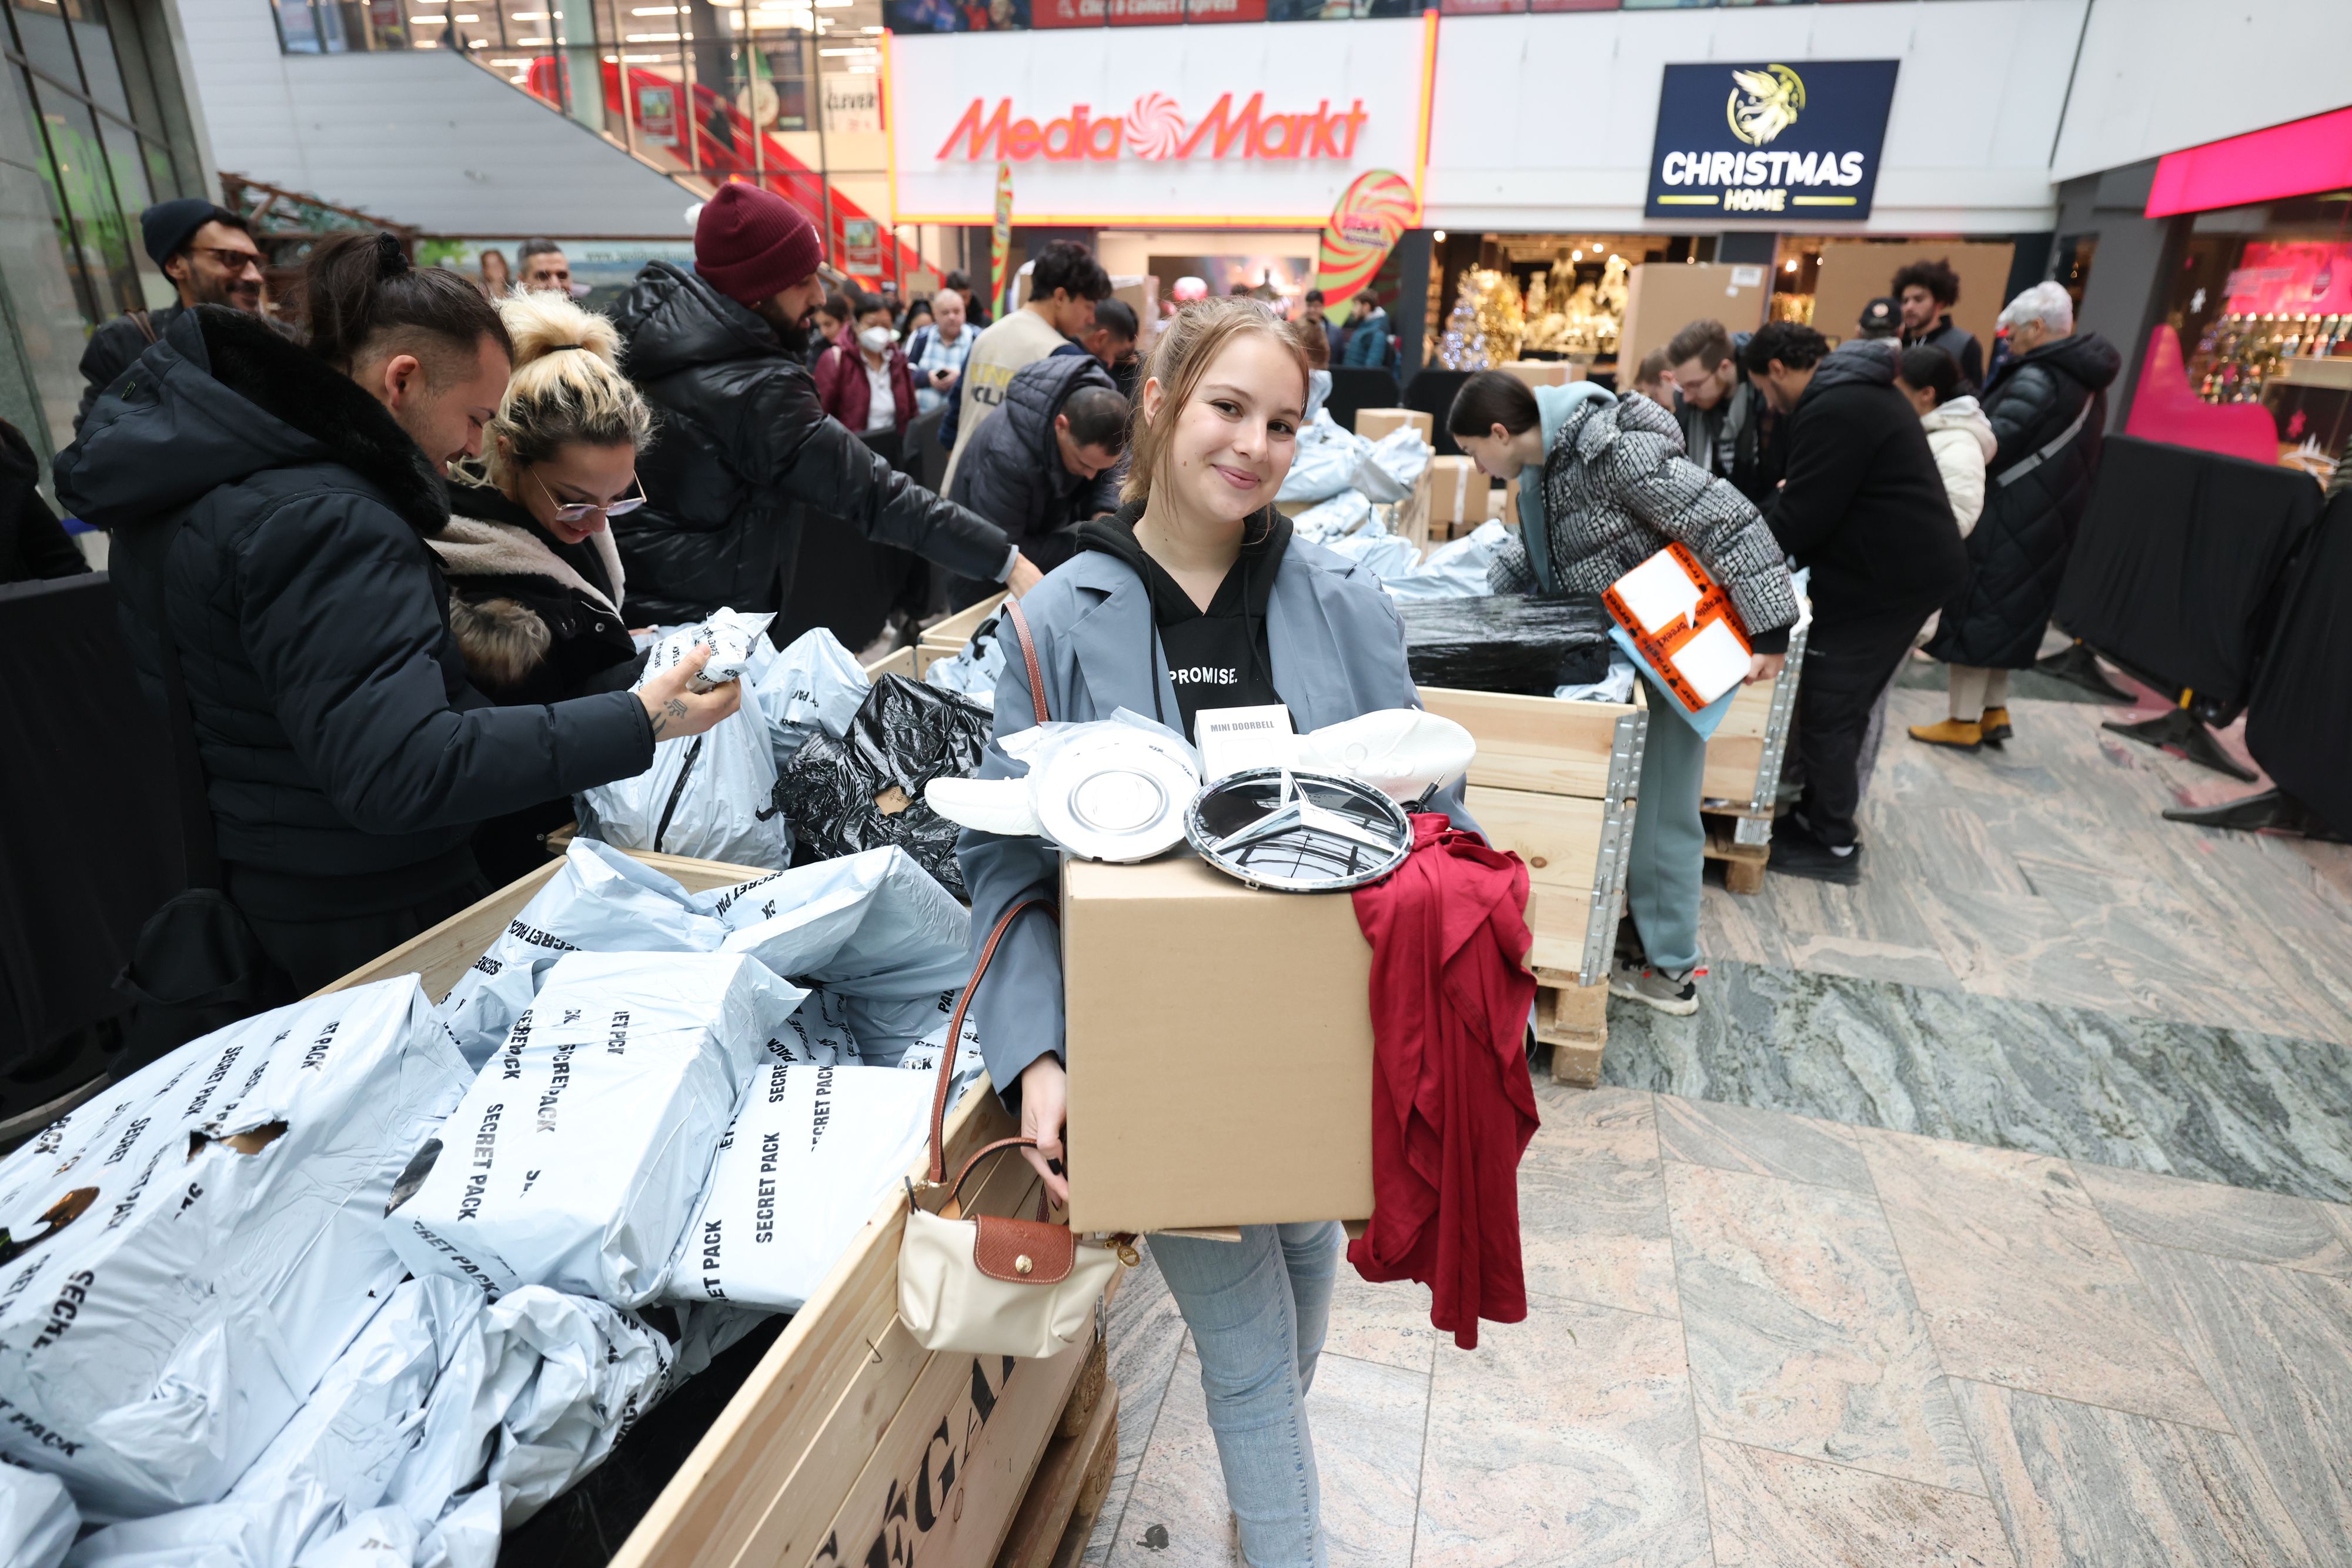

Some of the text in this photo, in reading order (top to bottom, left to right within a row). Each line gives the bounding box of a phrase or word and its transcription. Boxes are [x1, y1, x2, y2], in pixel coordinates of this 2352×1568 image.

[934, 91, 1369, 162] Media Markt
[1662, 151, 1865, 186] CHRISTMAS
[1723, 188, 1788, 212] HOME
[1672, 544, 1701, 579] fragile
[1696, 596, 1723, 616] fragile
[1169, 667, 1238, 684] PROMISE.
[1211, 720, 1275, 733] MINI DOORBELL
[734, 870, 785, 901] SECRET
[524, 927, 583, 951] ECRET
[472, 955, 503, 976] SECRE
[563, 1008, 582, 1025] CK
[204, 1045, 244, 1086] SECRET
[300, 1037, 333, 1072] PACK
[502, 1045, 522, 1081] PCK
[181, 1085, 218, 1120] PACK
[811, 1065, 834, 1152] ECRET PACK
[103, 1117, 152, 1166] SECRET
[457, 1104, 504, 1222] SECRET PACK
[756, 1132, 780, 1244] SECRET PACK
[703, 1219, 722, 1270] PACK
[451, 1255, 501, 1293] PACK
[9, 1412, 85, 1458] PACK
